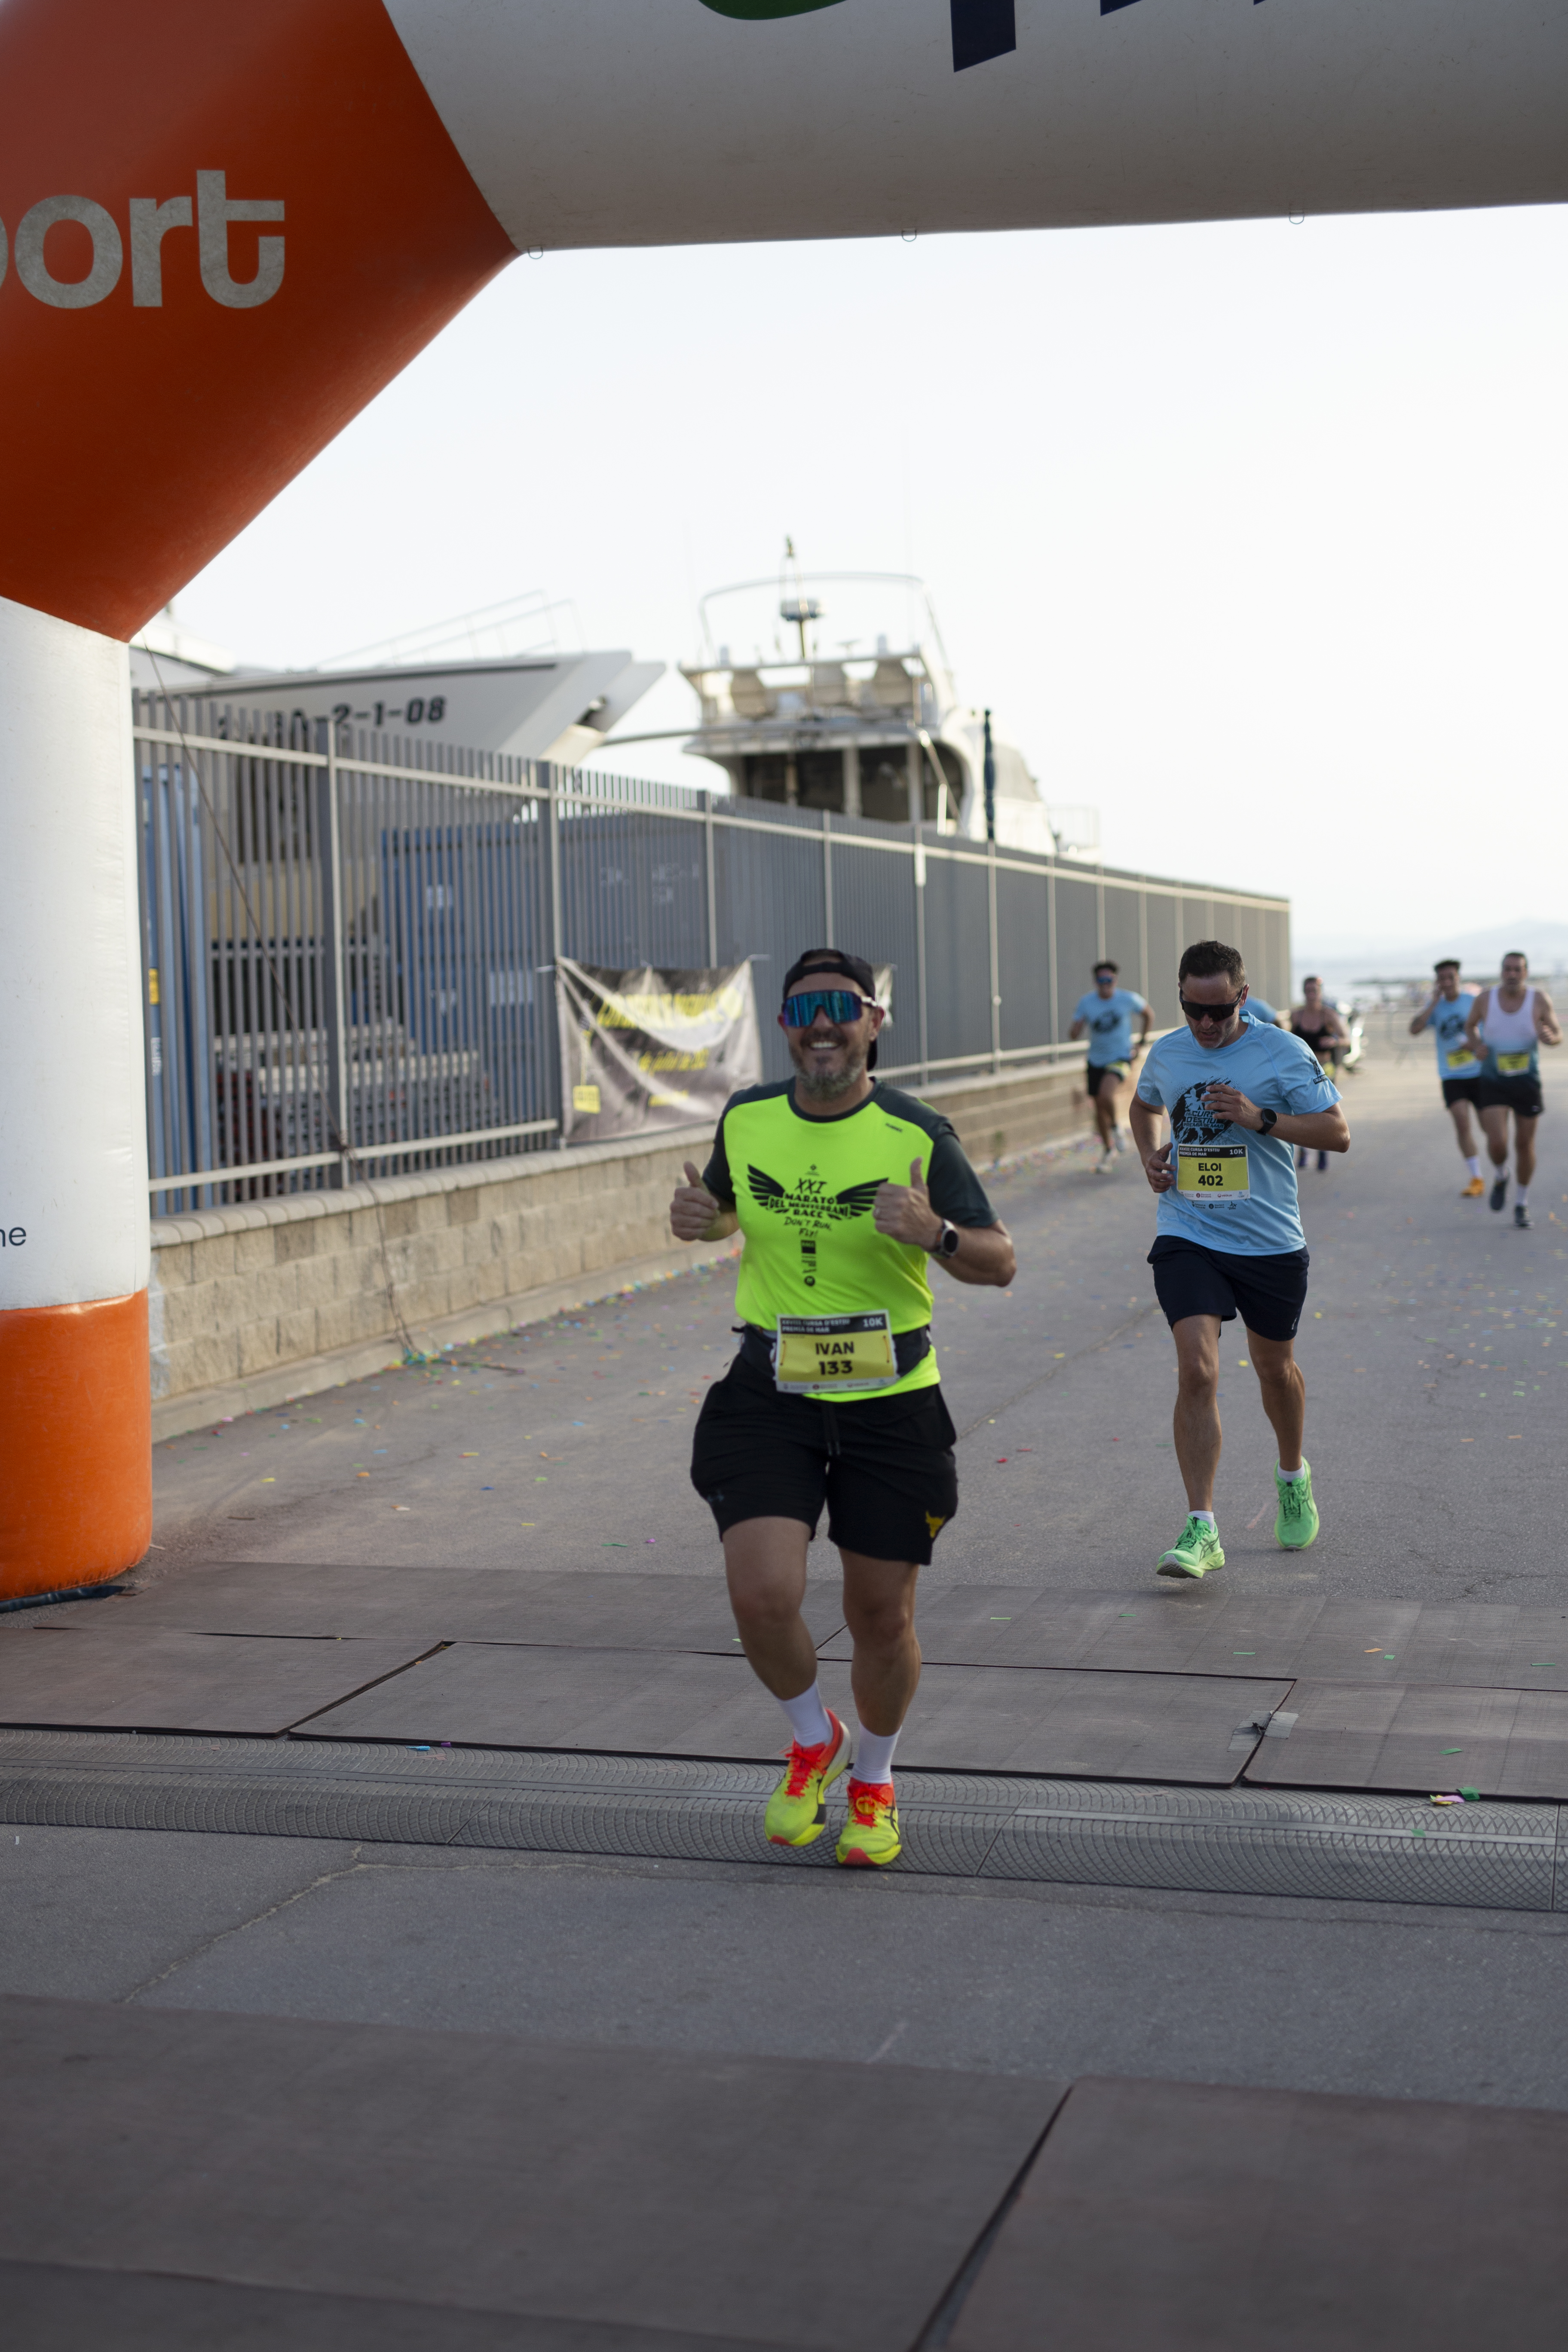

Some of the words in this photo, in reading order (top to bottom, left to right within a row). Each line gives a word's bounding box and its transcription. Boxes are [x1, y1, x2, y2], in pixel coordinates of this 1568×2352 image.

[0, 169, 285, 309] ort
[1198, 1163, 1222, 1171] ELOI
[794, 1178, 827, 1194] XXI
[1198, 1175, 1223, 1186] 402
[770, 1198, 785, 1208] DEL
[793, 1209, 823, 1219] RACC
[863, 1317, 883, 1328] 10K
[815, 1341, 854, 1355] IVAN
[819, 1360, 852, 1375] 133
